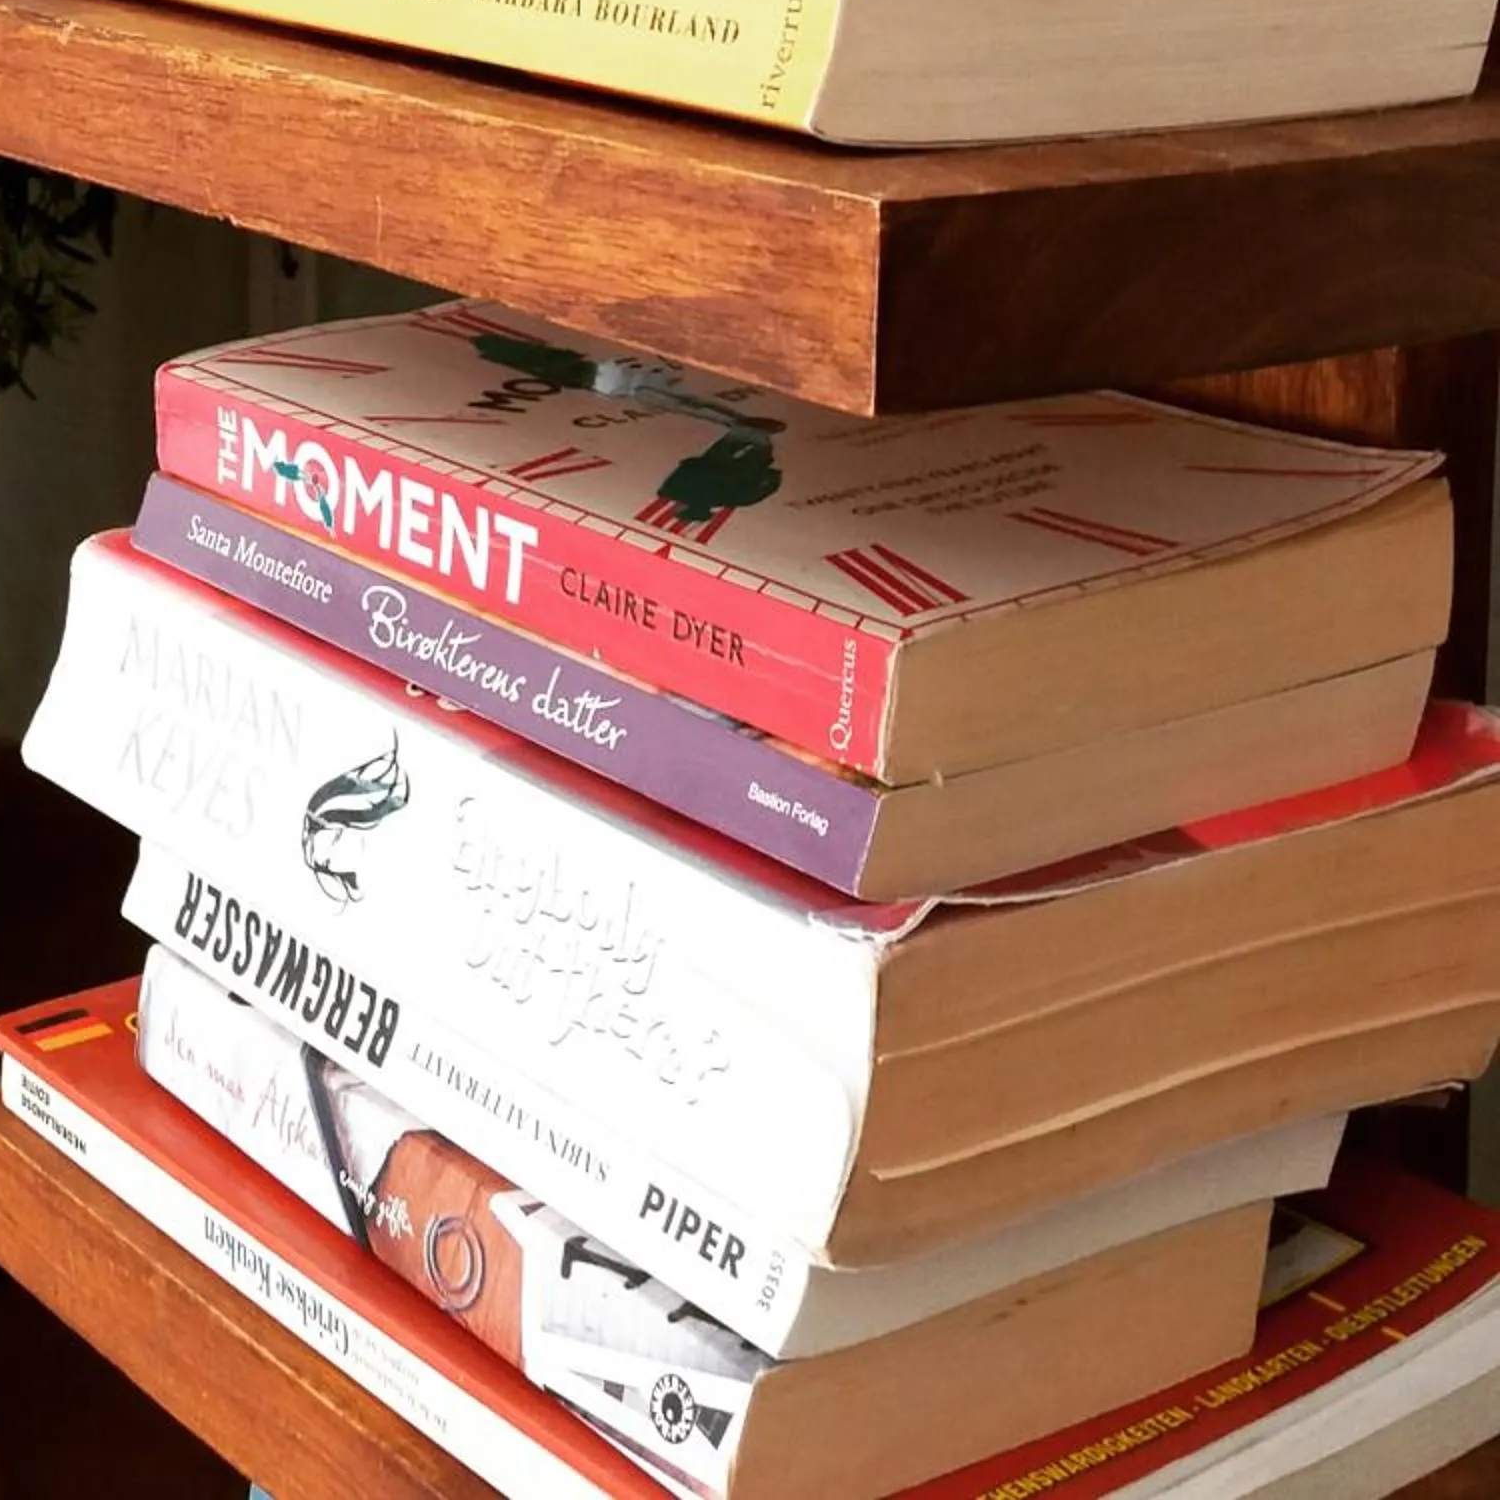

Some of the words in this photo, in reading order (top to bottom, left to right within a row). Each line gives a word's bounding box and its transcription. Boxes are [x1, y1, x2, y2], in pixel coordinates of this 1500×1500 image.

[216, 404, 238, 483] THE
[242, 415, 539, 605] MOMENT
[186, 514, 232, 557] Santa
[233, 533, 333, 604] Montefiore
[361, 584, 528, 703] Birøkterens
[532, 672, 628, 751] datter
[560, 566, 659, 632] CLAIRE
[670, 611, 746, 668] DYER
[118, 613, 302, 766] MARIAN
[828, 638, 858, 752] Quercus
[115, 711, 267, 842] KEYES
[747, 780, 789, 813] Bastion
[789, 798, 830, 836] Forlag
[174, 869, 400, 1069] BERGWASSER
[203, 1214, 272, 1298] Keuken
[638, 1182, 746, 1280] PIPER
[276, 1271, 350, 1357] Griekse
